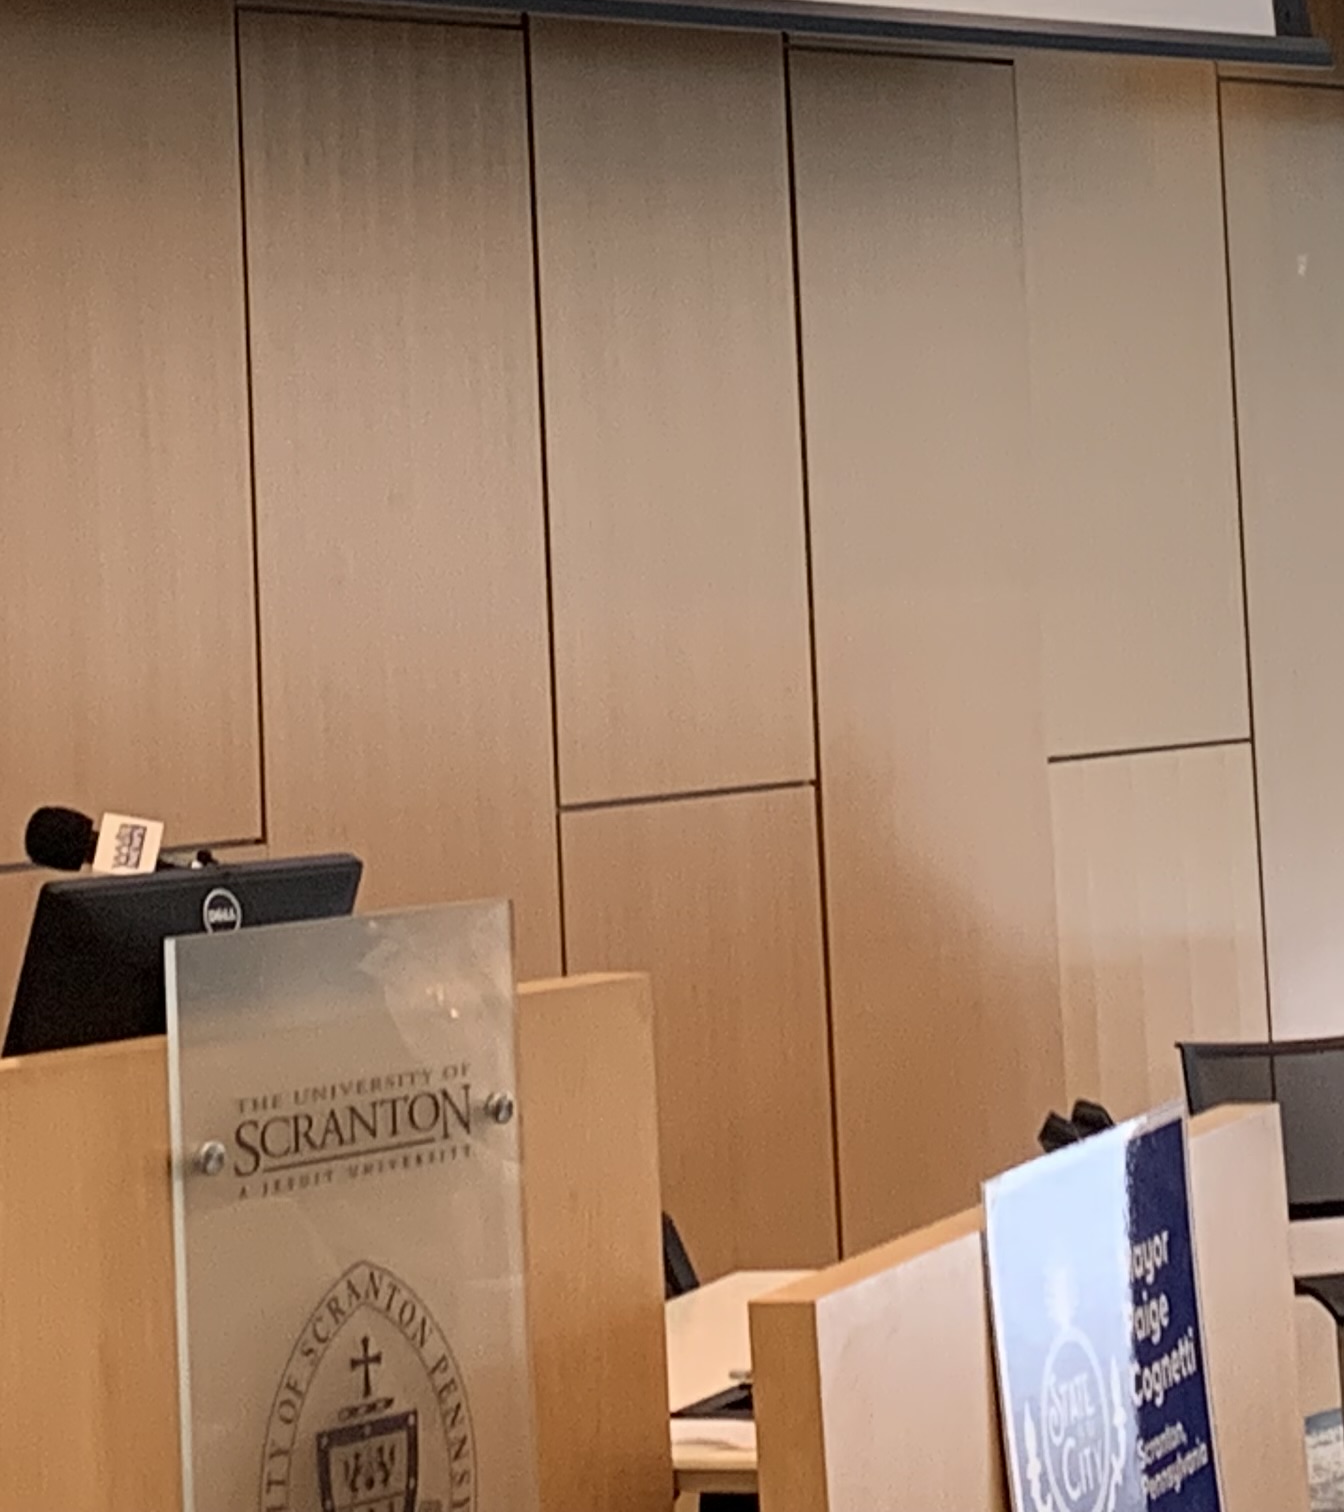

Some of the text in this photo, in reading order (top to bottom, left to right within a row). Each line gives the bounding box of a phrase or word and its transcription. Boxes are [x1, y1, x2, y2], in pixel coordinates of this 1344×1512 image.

[238, 1061, 472, 1115] THE UNIVERSITY OF
[233, 1083, 472, 1178] SCRANTON
[1130, 1230, 1170, 1285] ayor
[278, 1377, 306, 1426] OF
[300, 1270, 434, 1367] SCRANTON
[1131, 1289, 1170, 1345] aige
[1132, 1325, 1198, 1408] Cognetti
